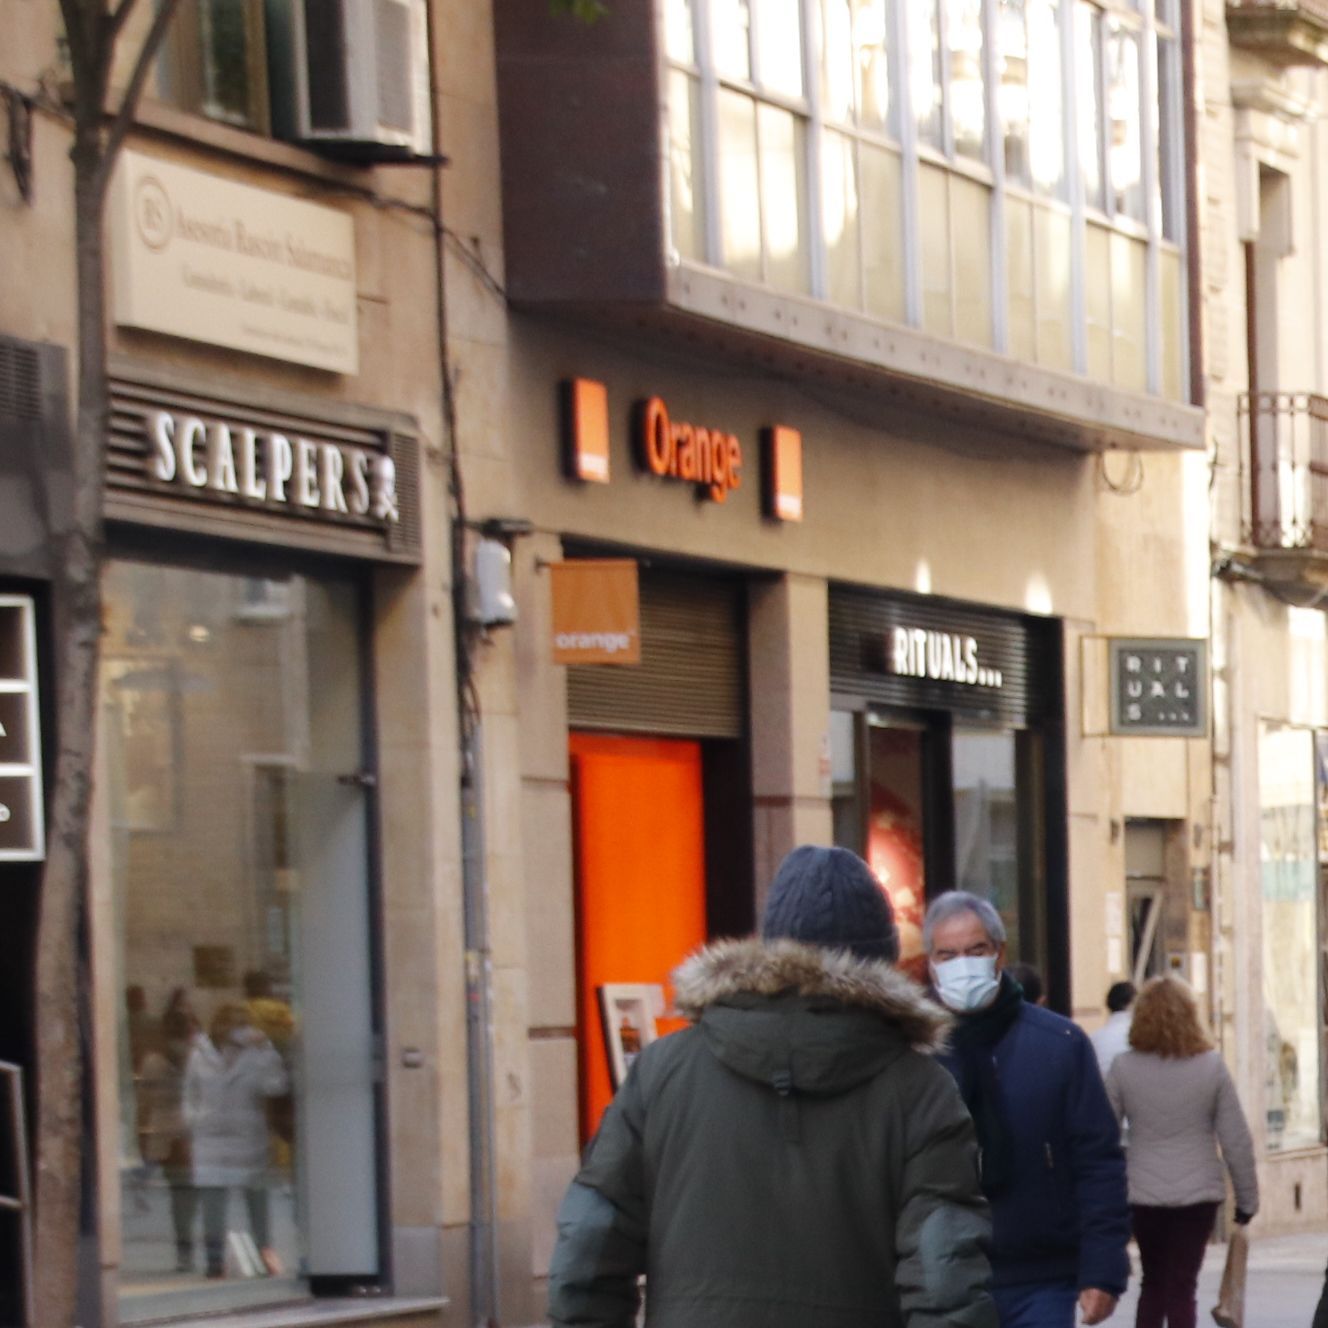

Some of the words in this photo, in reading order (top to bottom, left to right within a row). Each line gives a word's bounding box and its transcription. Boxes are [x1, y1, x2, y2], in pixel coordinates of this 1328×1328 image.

[154, 411, 370, 515] SCALPERS
[645, 396, 742, 503] Orange
[556, 633, 629, 653] orange
[893, 627, 1002, 688] RITUALS...
